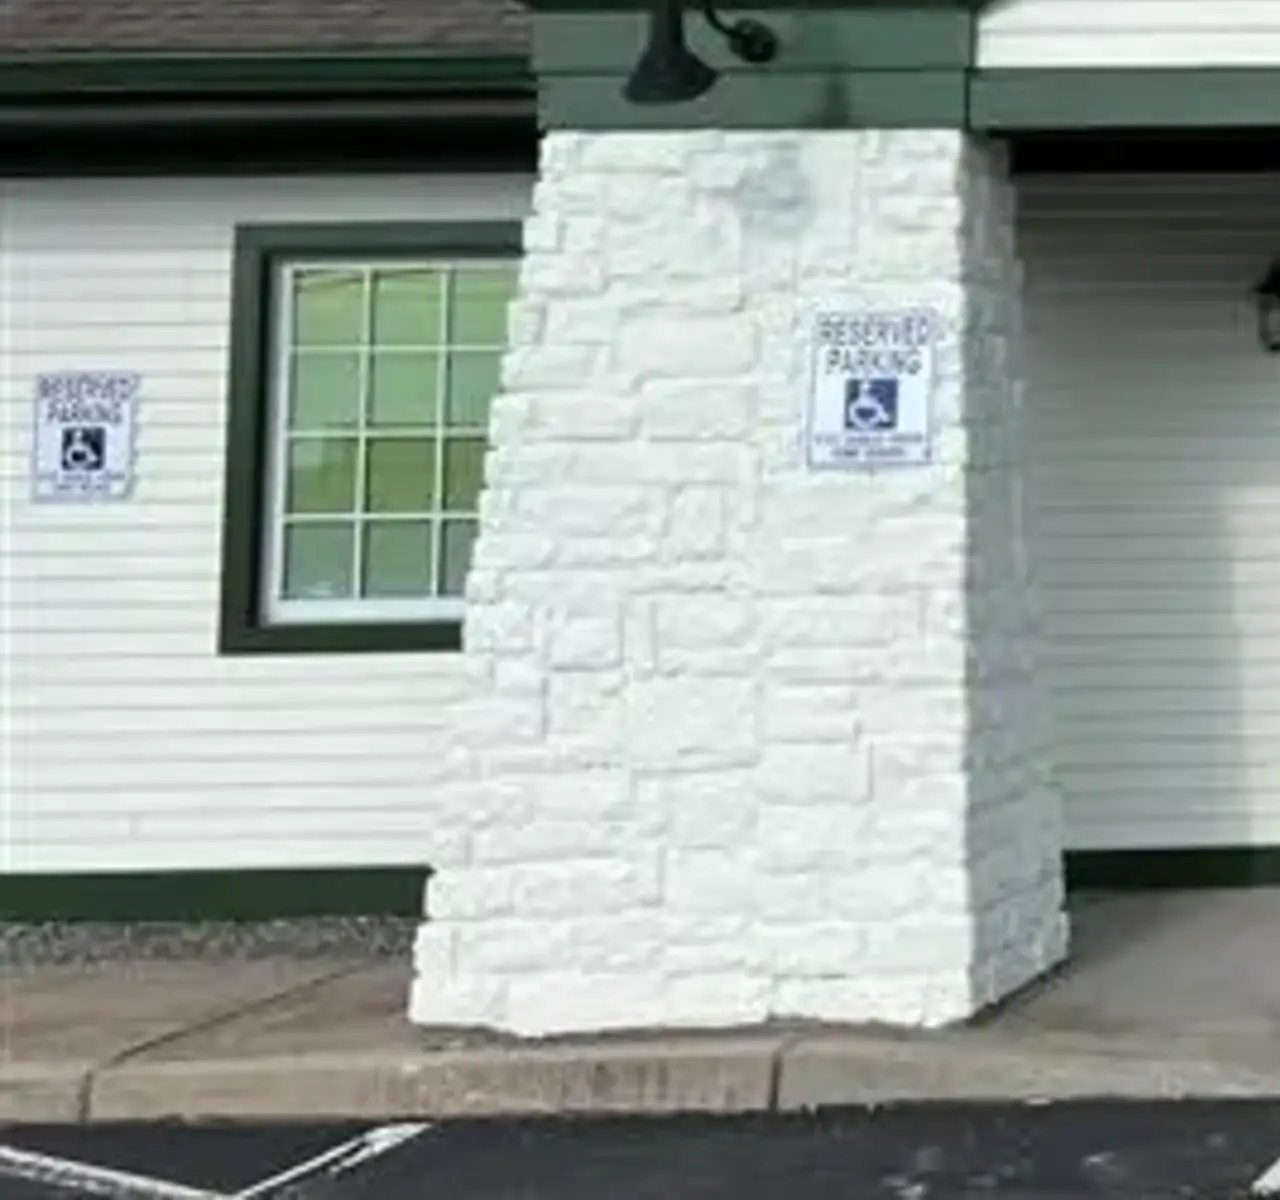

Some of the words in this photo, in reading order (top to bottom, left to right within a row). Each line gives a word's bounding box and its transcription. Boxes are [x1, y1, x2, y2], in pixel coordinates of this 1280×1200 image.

[819, 314, 930, 346] RESERVED
[824, 348, 922, 375] PARKING
[47, 401, 122, 425] PARKING
